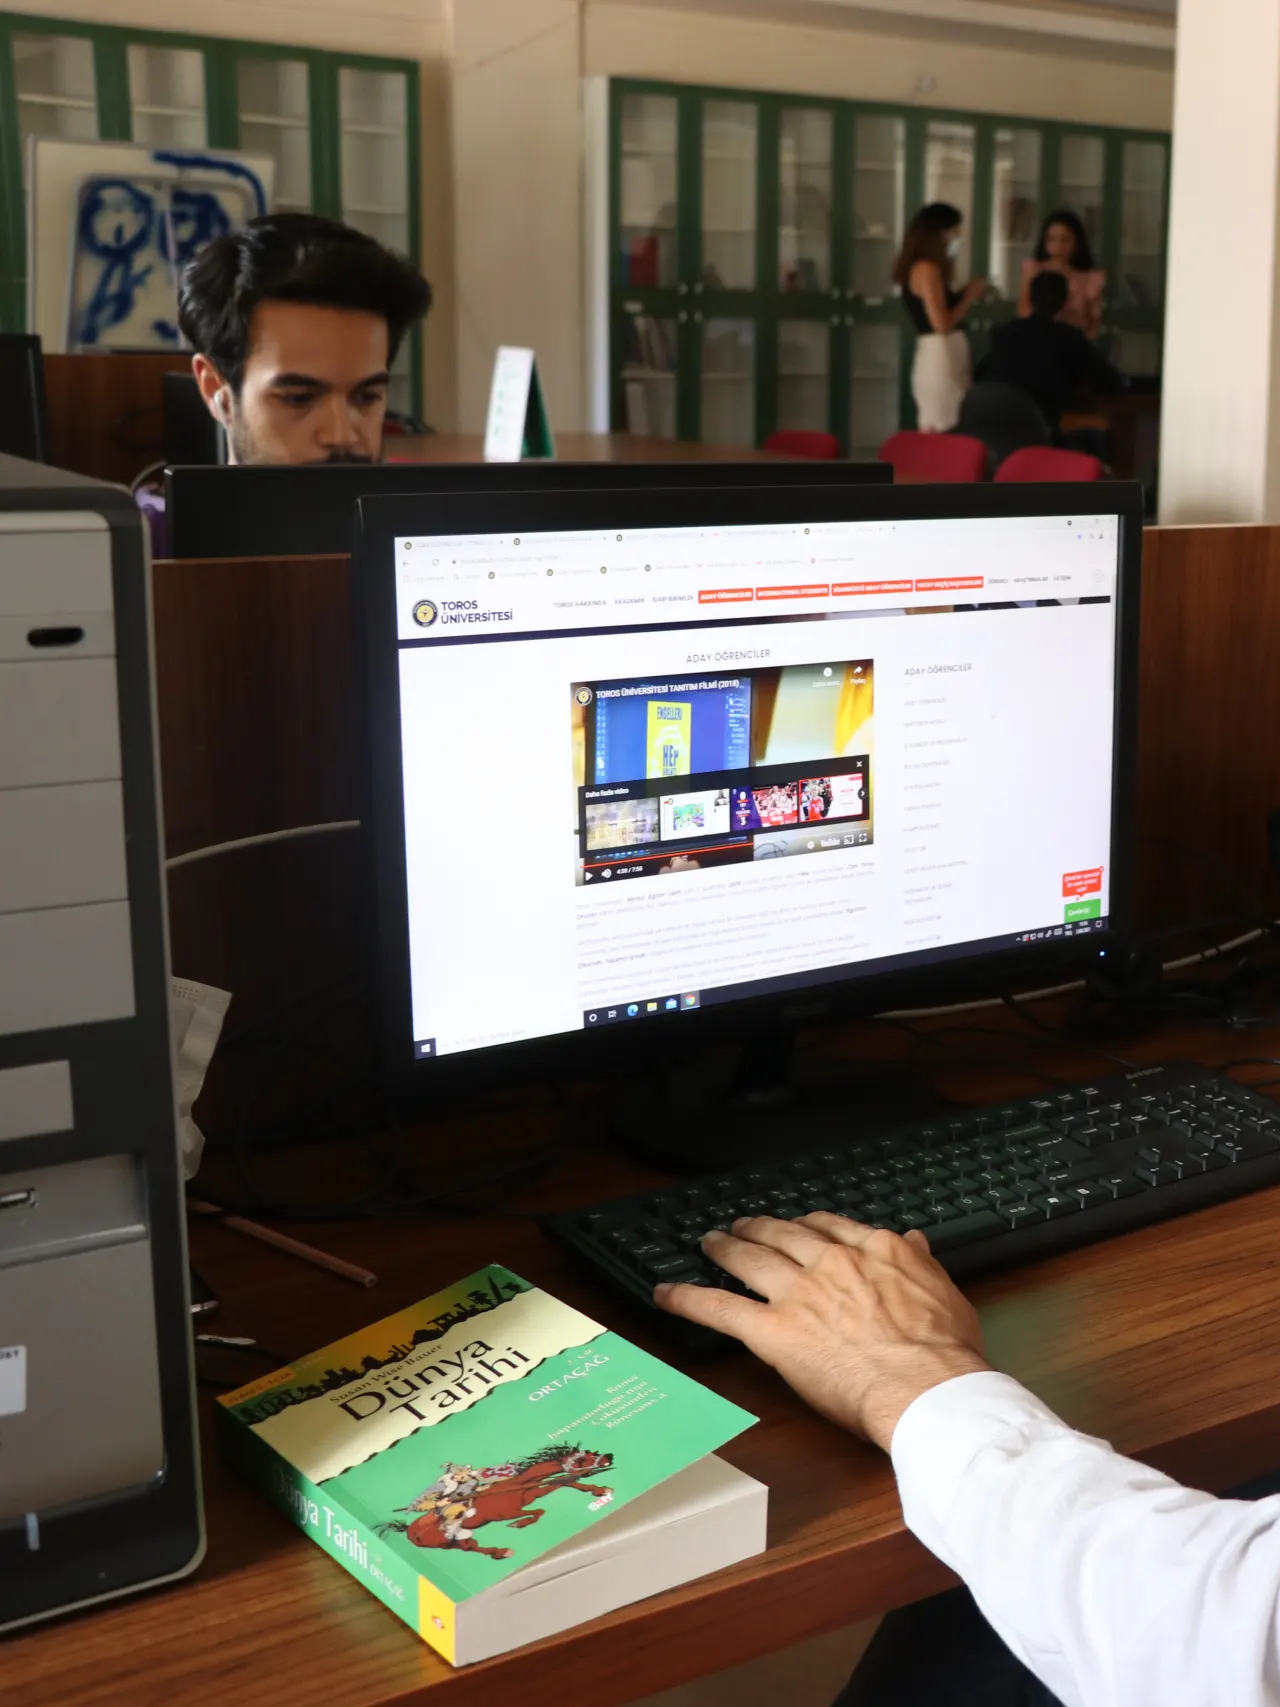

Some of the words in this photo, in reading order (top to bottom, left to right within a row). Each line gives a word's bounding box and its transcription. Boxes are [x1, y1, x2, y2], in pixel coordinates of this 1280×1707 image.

[440, 600, 479, 611] TOROS
[440, 608, 514, 625] ÜNİVERSİTESİ
[686, 654, 712, 664] ADAY
[714, 648, 771, 662] ÖĞRENCİLER
[904, 668, 925, 676] ADAY
[595, 689, 621, 699] TOROS
[621, 684, 669, 697] ÜNİVERSİTESİ
[669, 682, 699, 693] TANITIM
[699, 680, 718, 691] FİLMİ
[718, 678, 740, 690] (2018)
[329, 1382, 372, 1404] Susan
[371, 1364, 404, 1383] Wise
[404, 1344, 443, 1367] Bauer
[337, 1339, 496, 1422] Dünya
[389, 1346, 532, 1421] Tarihi
[527, 1353, 610, 1402] ORTAÇAĞ
[606, 1374, 640, 1395] Roma
[323, 1504, 369, 1570] Tarihi
